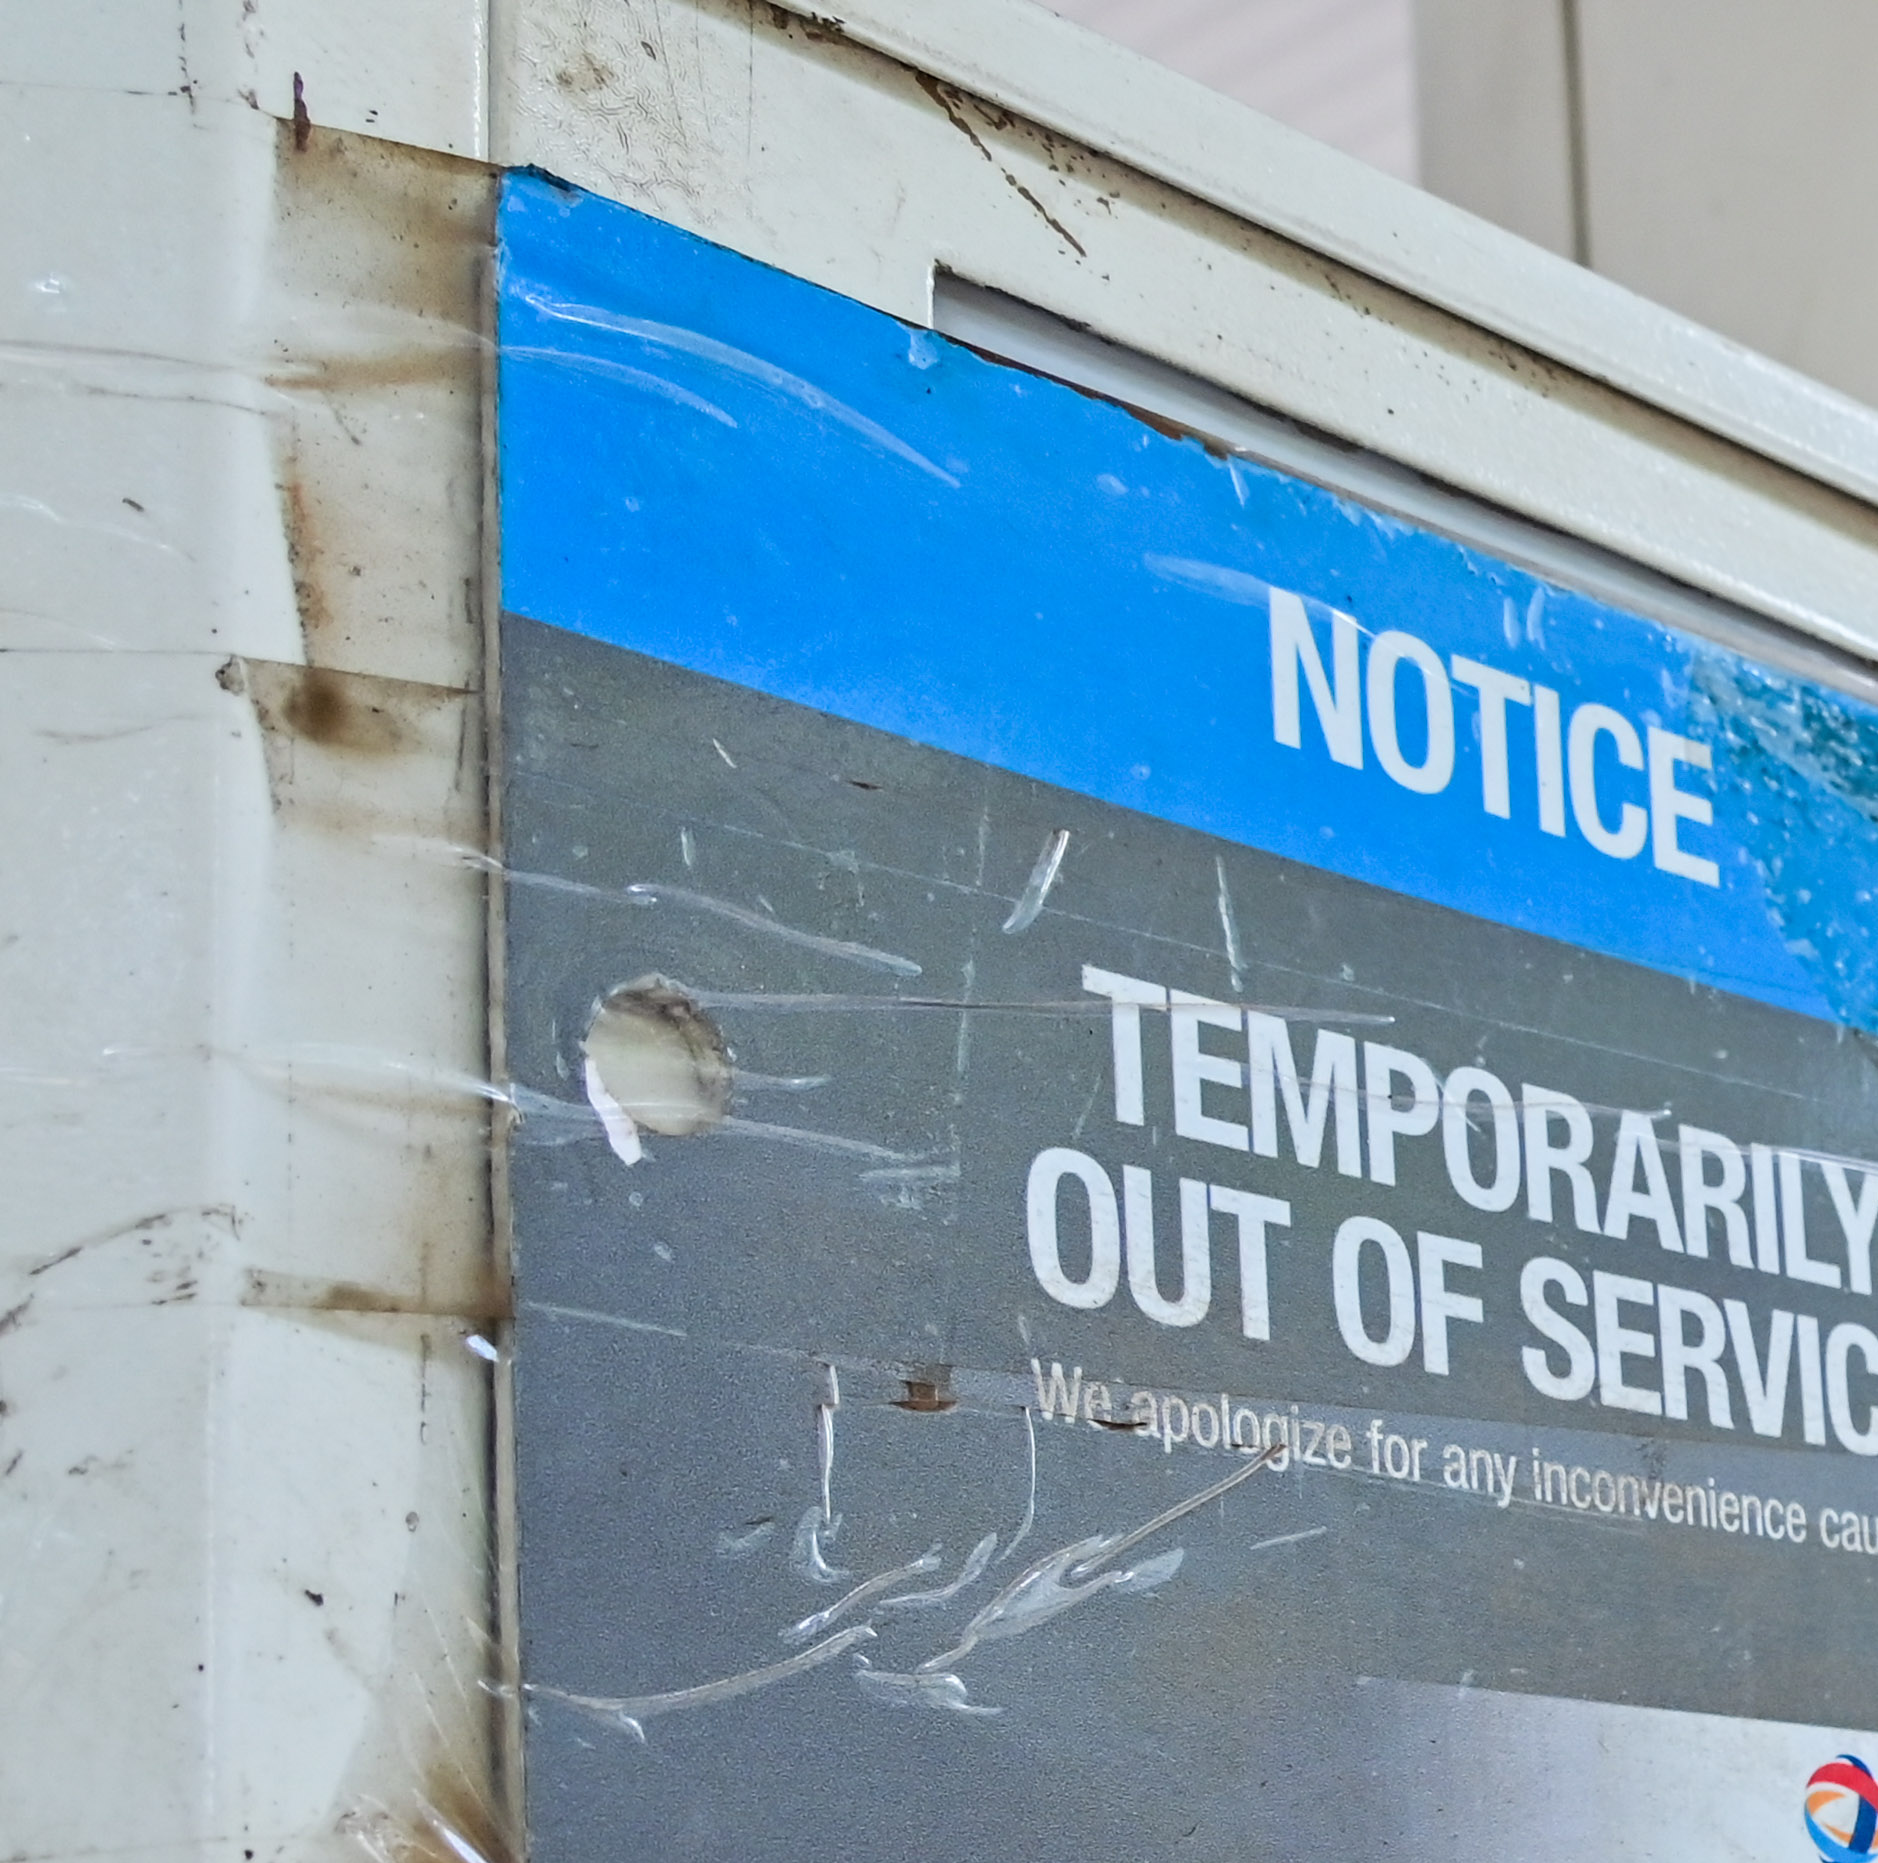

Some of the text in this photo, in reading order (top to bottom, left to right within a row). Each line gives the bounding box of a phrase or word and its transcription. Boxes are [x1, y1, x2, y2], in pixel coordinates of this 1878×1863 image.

[1268, 586, 1720, 887] NOTICE
[1026, 1149, 1291, 1340] OUT
[1331, 1214, 1483, 1376] OF
[1030, 1358, 1112, 1430] We
[1131, 1390, 1352, 1472] apologize
[1366, 1419, 1428, 1481] for
[1442, 1443, 1517, 1508] any
[1533, 1447, 1807, 1543] inconvenience
